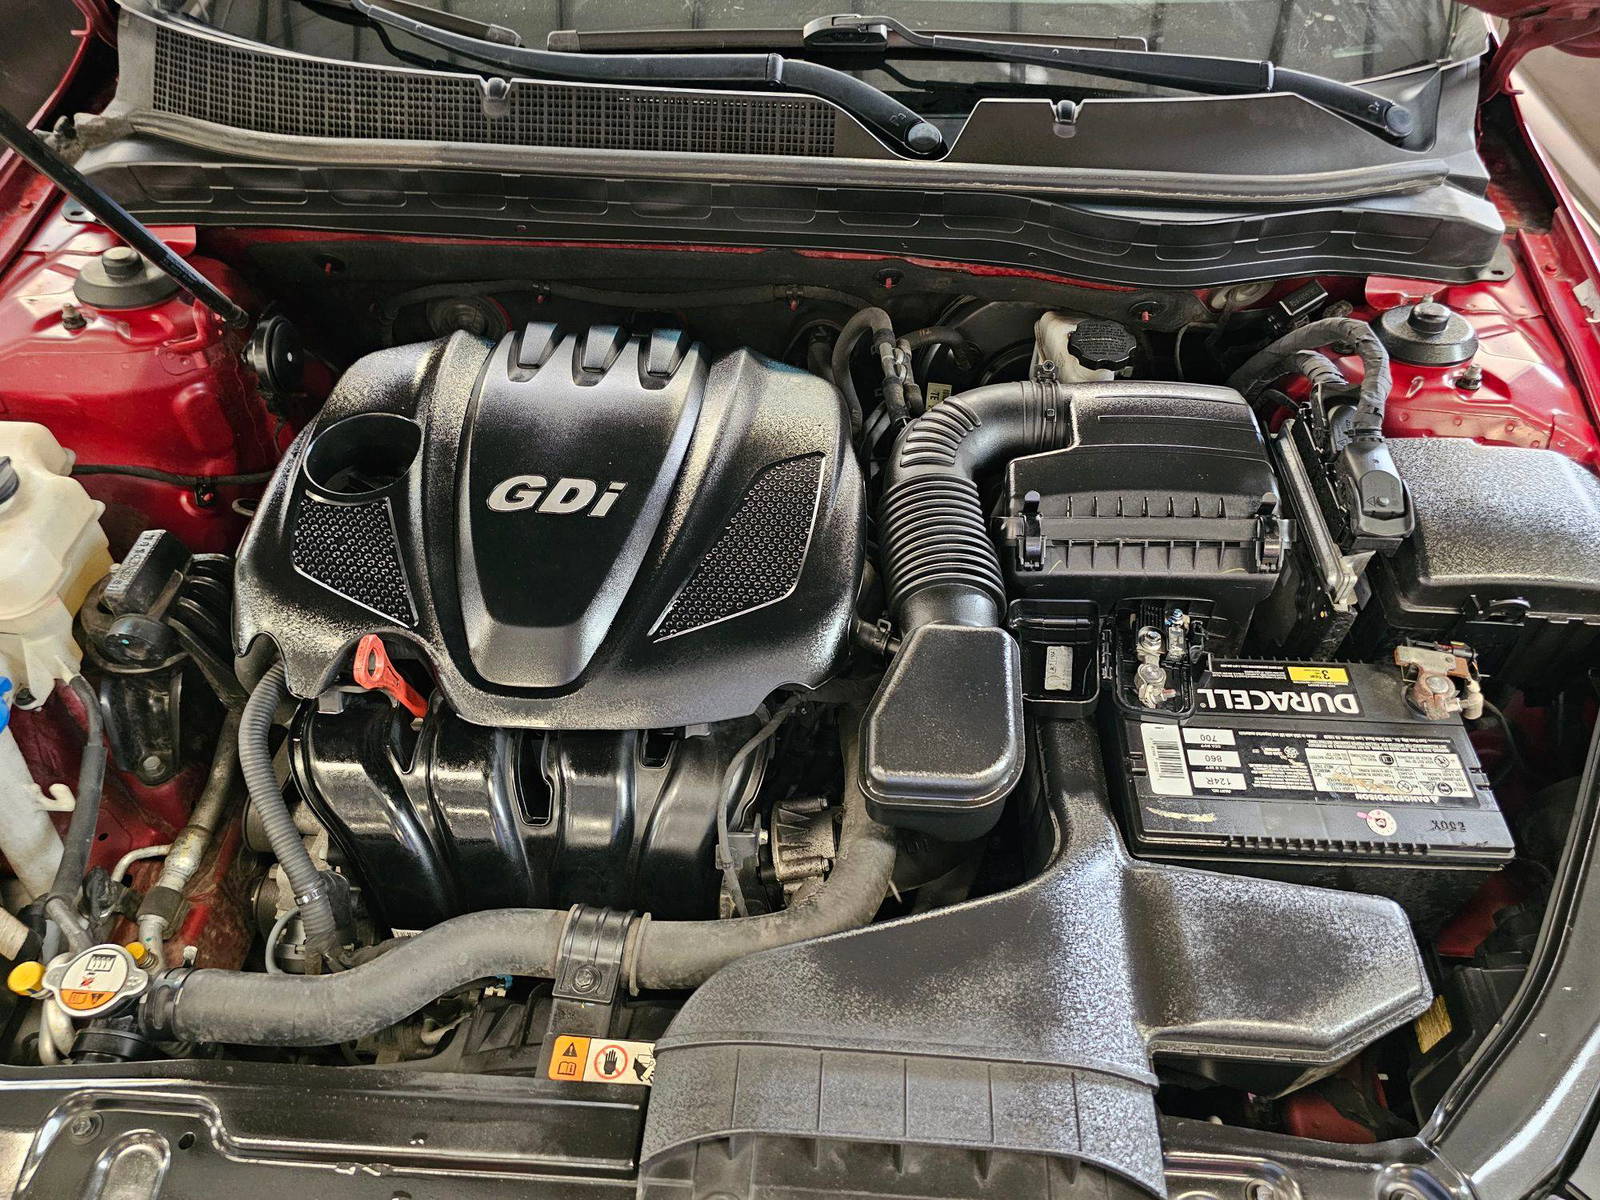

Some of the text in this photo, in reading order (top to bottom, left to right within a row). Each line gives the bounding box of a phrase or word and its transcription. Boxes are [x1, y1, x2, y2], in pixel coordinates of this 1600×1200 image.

[486, 475, 628, 518] GDi
[1322, 669, 1330, 680] 3
[1197, 688, 1360, 714] DURACELL
[1205, 755, 1222, 763] 860
[1206, 777, 1231, 786] 124R
